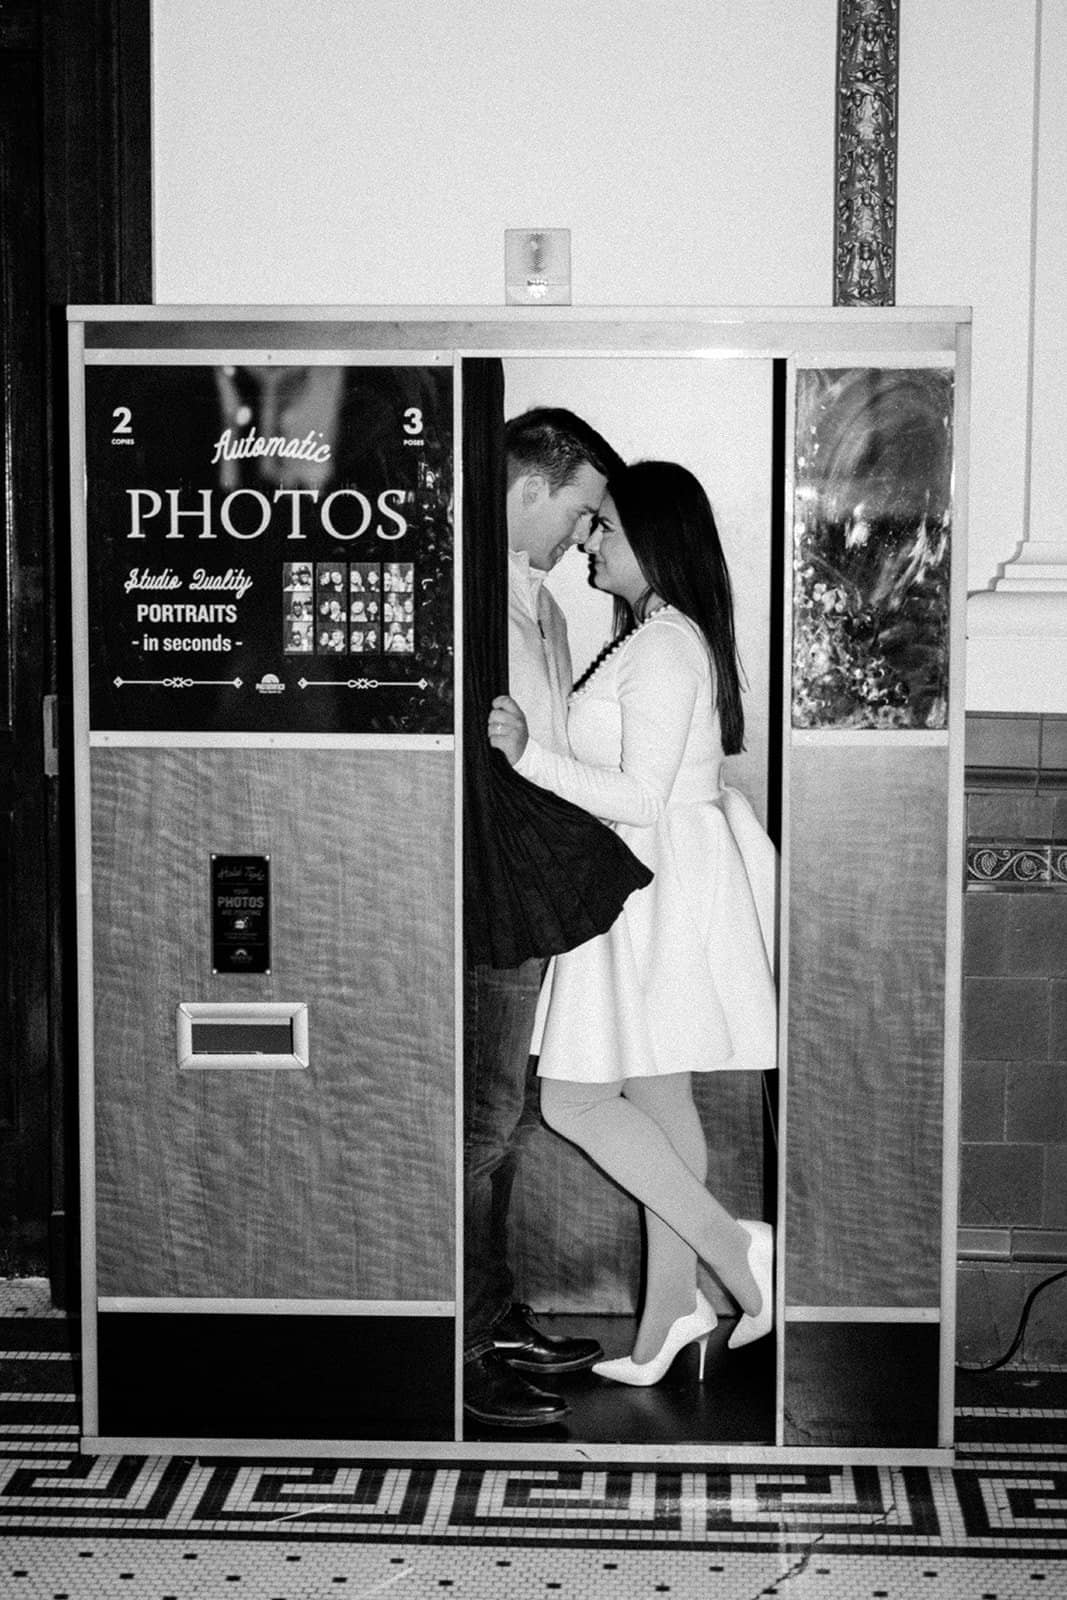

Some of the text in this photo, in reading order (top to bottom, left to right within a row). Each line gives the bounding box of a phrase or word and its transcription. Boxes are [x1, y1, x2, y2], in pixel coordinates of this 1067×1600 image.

[111, 406, 132, 434] 2
[403, 407, 423, 435] 3
[111, 438, 135, 446] COPIES
[210, 426, 331, 464] Automatic
[125, 489, 408, 540] PHOTOS
[124, 568, 253, 600] Studio Quality
[136, 604, 238, 623] PORTRAITS
[217, 896, 264, 909] PHOTOS
